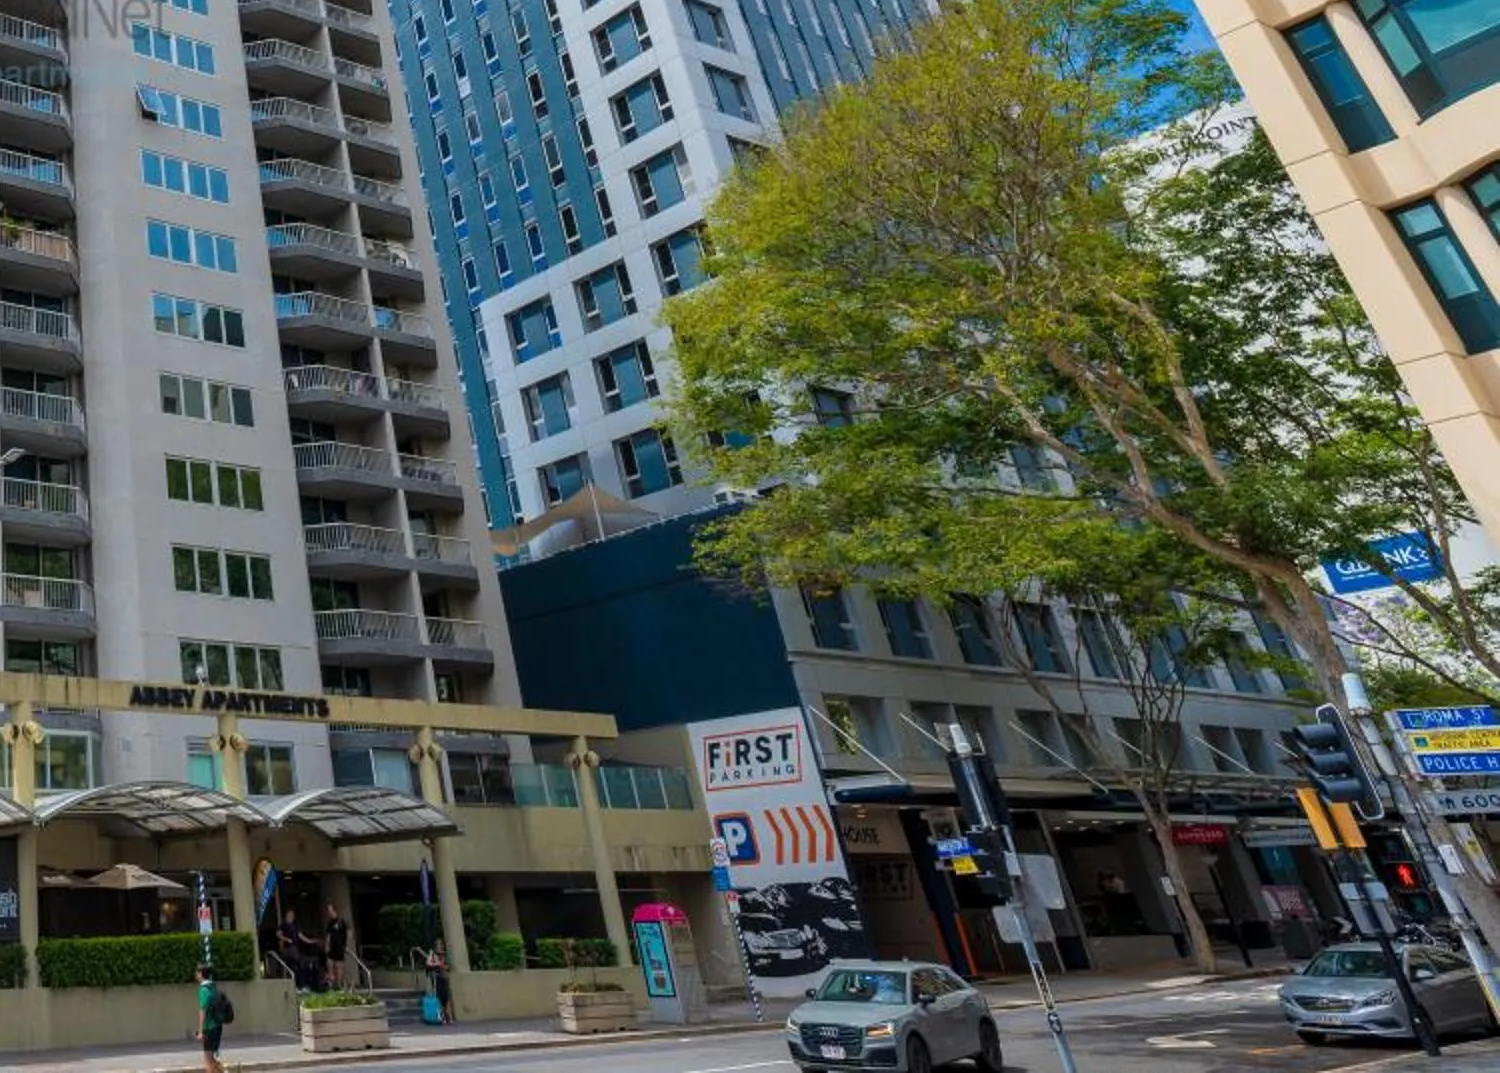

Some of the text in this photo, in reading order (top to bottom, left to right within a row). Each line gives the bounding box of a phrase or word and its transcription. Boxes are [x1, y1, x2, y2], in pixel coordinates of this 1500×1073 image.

[129, 685, 330, 719] ABBEY APARTMENTS
[1422, 709, 1464, 723] ROMA
[1423, 756, 1481, 770] POLICE
[709, 765, 795, 784] PARKING
[722, 821, 747, 857] P
